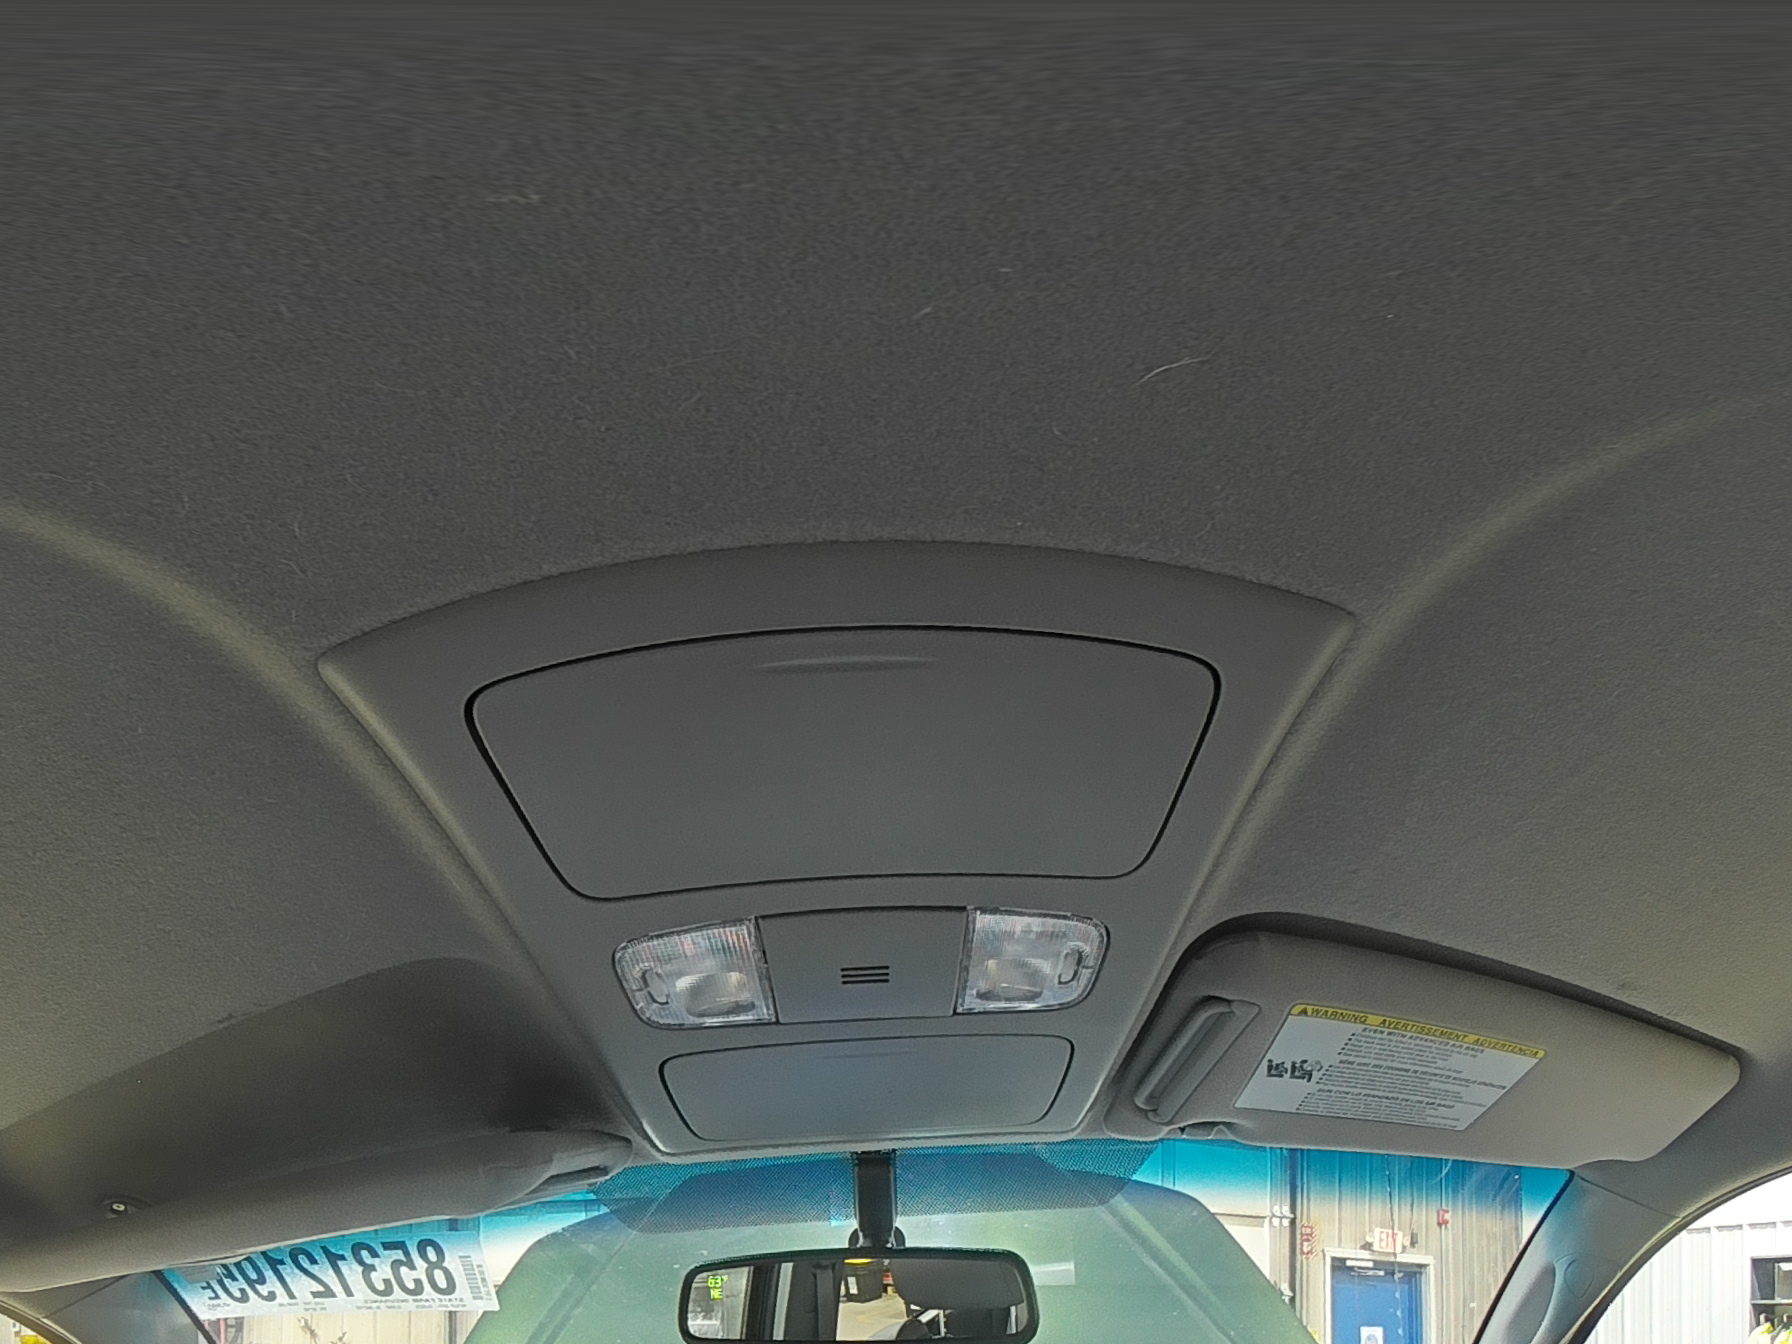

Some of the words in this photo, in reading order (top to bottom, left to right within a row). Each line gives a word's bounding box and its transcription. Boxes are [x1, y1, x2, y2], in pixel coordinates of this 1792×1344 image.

[1310, 1007, 1369, 1024] WARNING
[1378, 1018, 1470, 1042] AVERTISSEMENT
[1472, 1036, 1540, 1058] ADVERTENCIA
